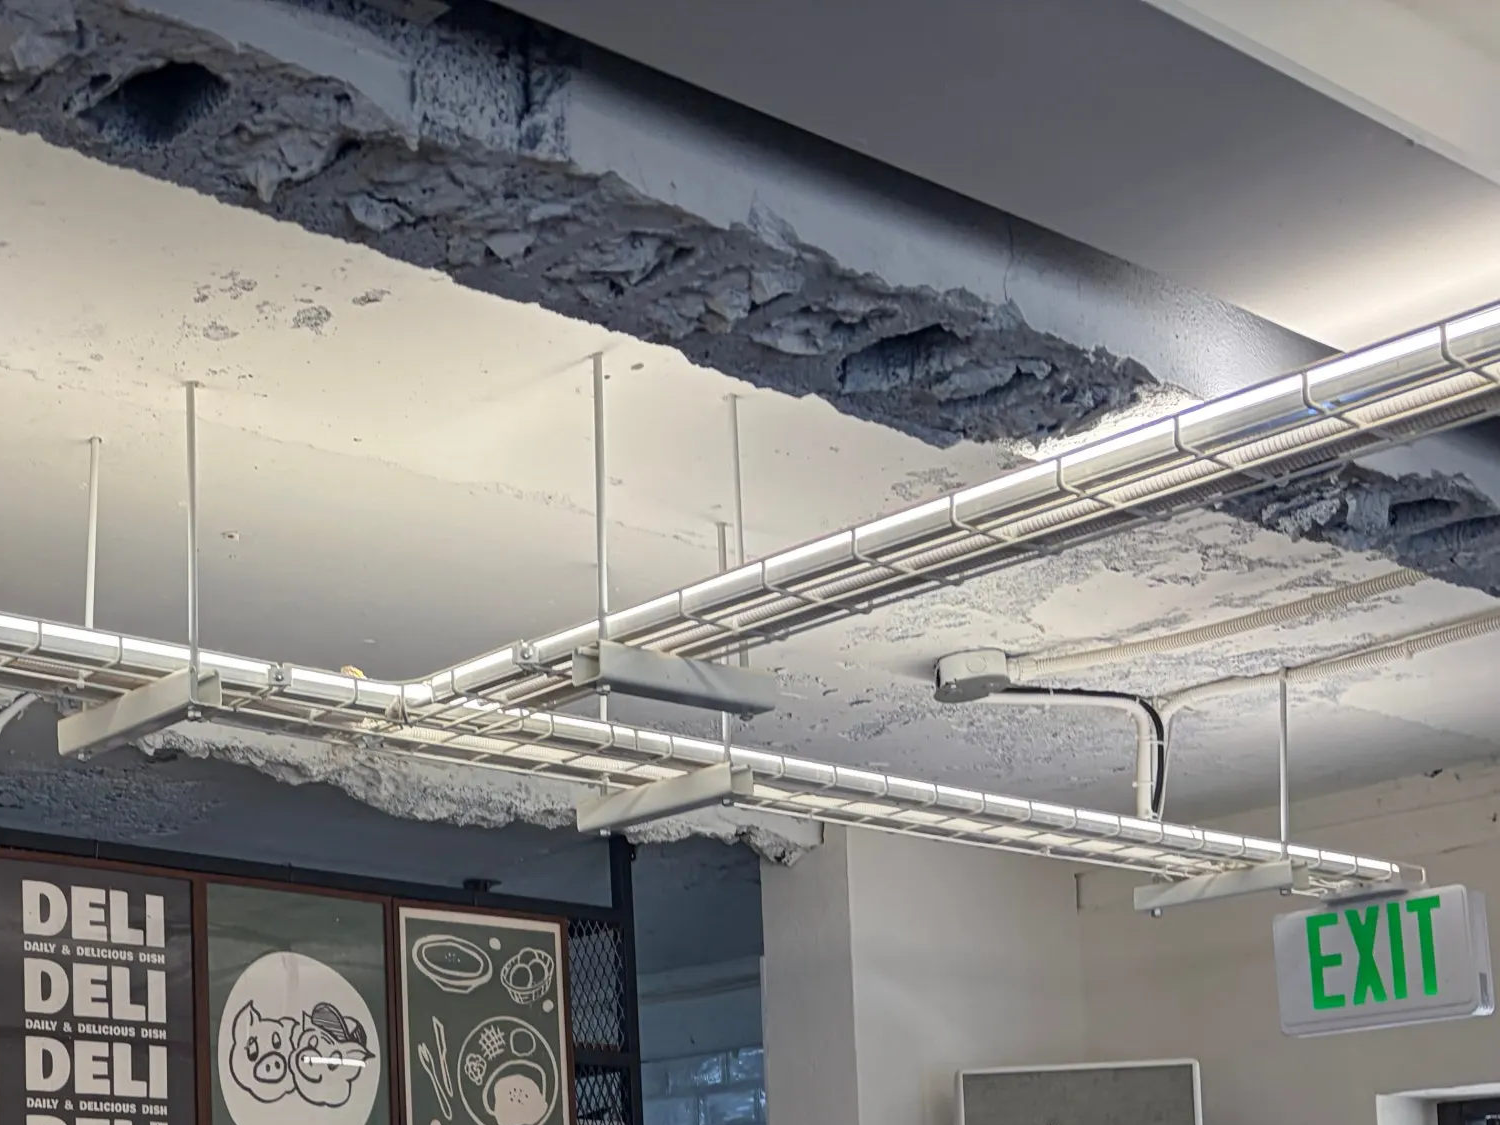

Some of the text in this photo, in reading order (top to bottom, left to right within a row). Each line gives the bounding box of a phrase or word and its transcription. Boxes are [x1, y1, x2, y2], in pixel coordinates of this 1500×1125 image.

[22, 879, 166, 948] DELI
[24, 941, 166, 964] DAILY & DELICIOUS DISH
[1306, 895, 1441, 1011] EXIT
[23, 957, 167, 1023] DELI
[25, 1018, 167, 1040] DAILY & DELICIOUS DISH
[25, 1035, 168, 1099] DELI
[26, 1097, 168, 1116] DAILY & DELICIOUS DISH
